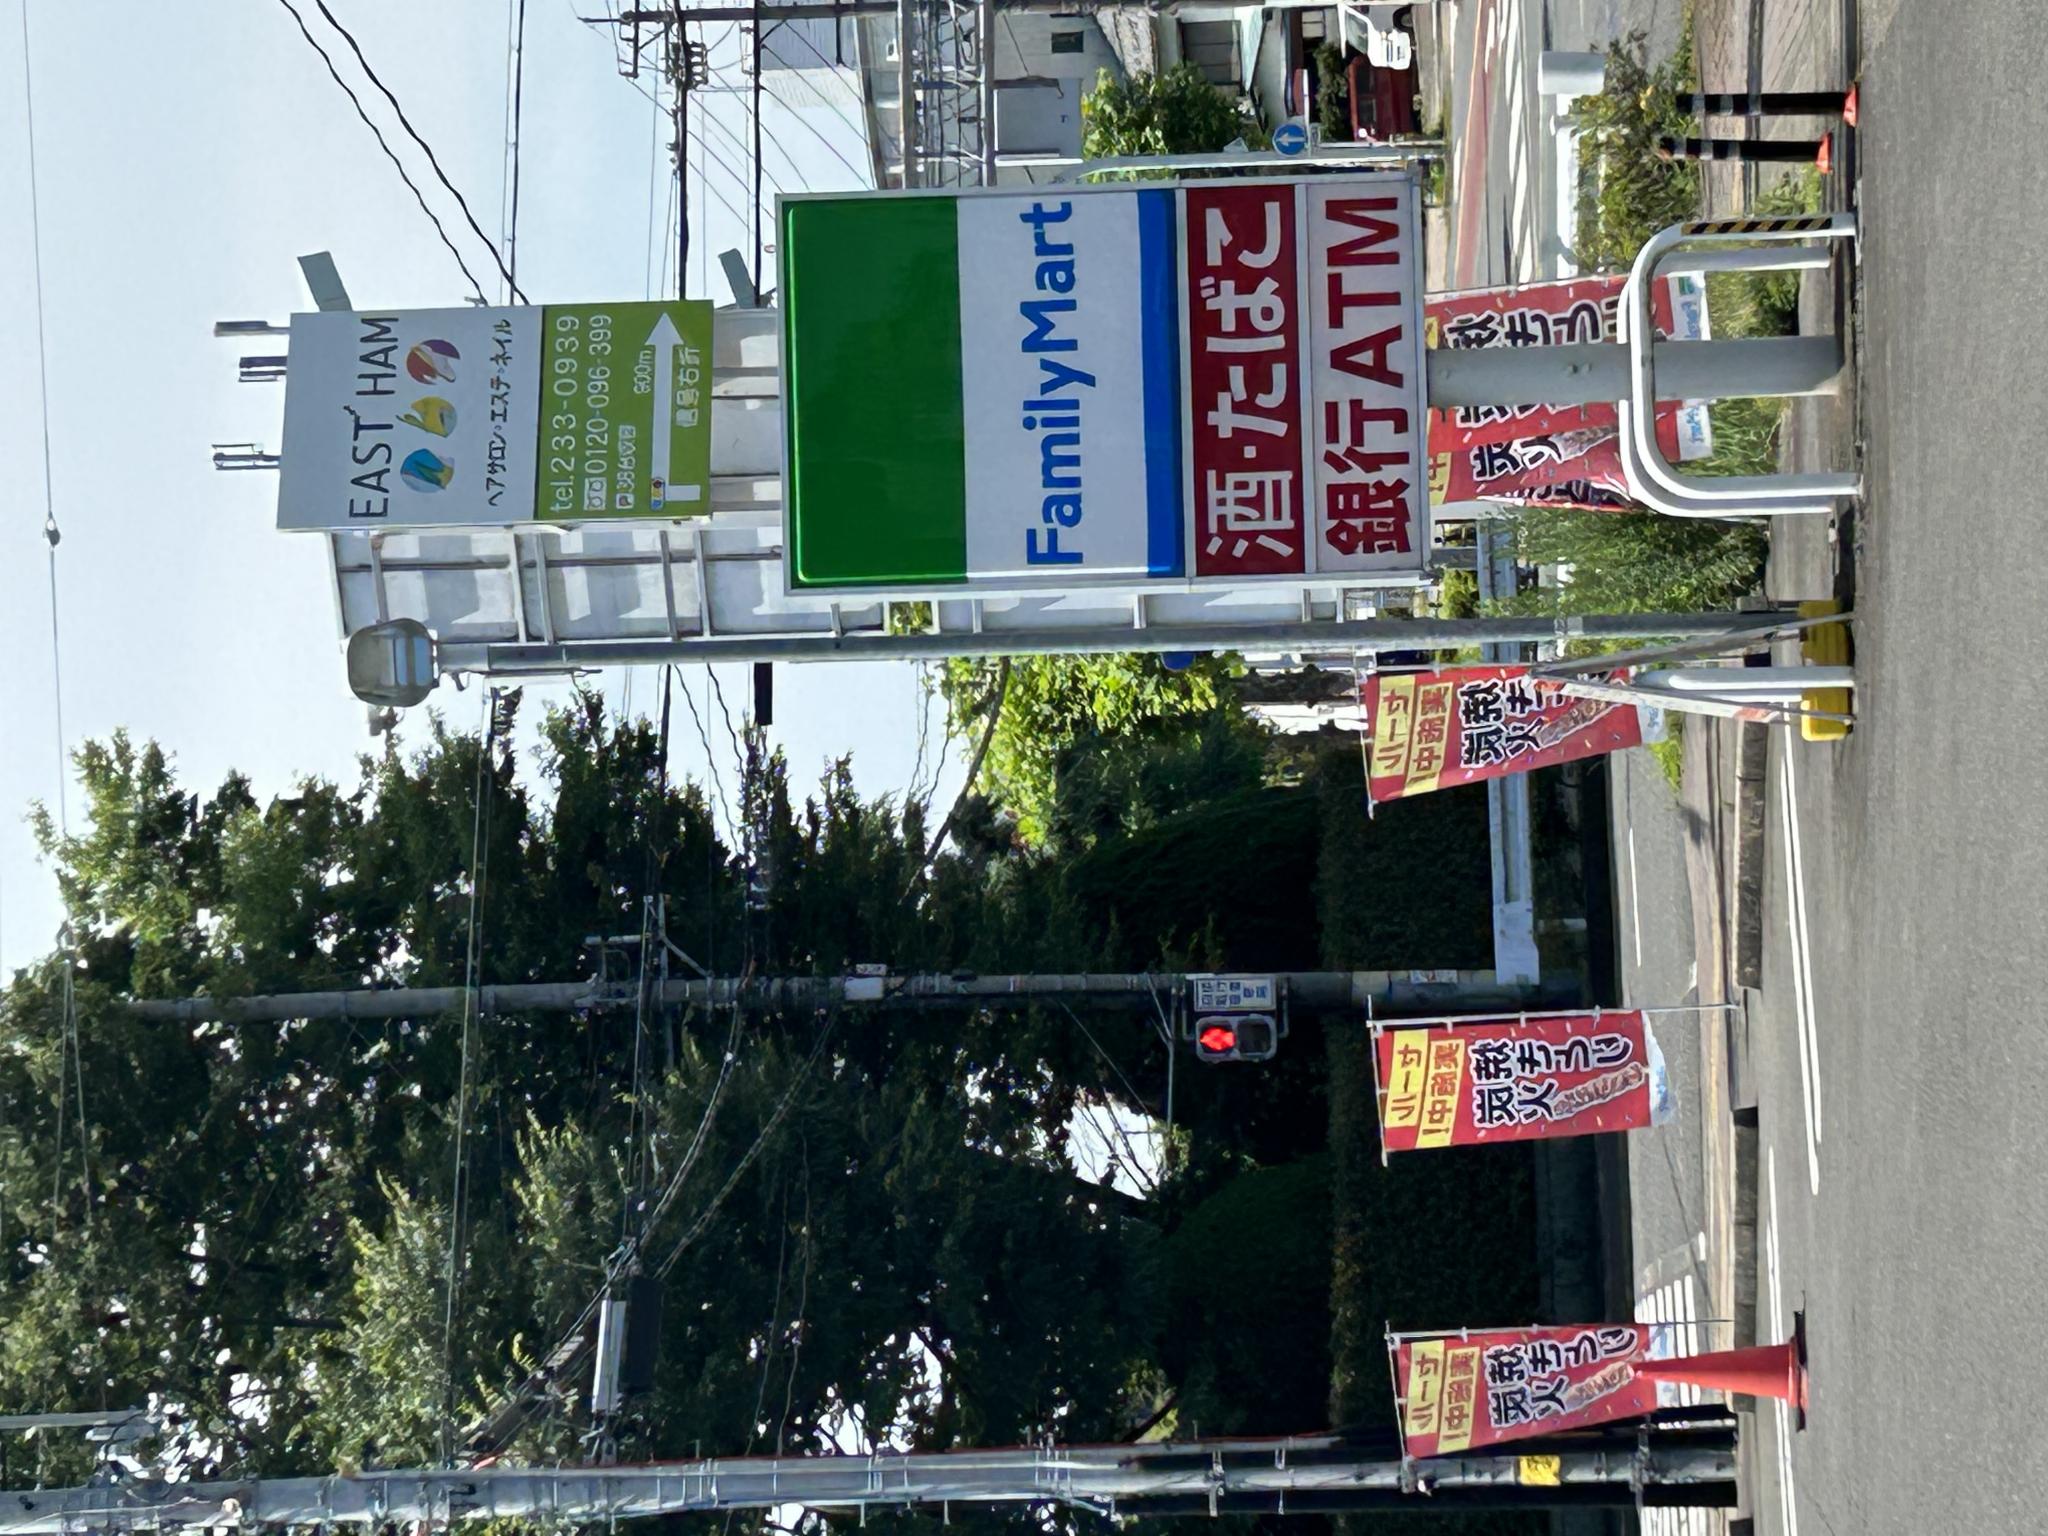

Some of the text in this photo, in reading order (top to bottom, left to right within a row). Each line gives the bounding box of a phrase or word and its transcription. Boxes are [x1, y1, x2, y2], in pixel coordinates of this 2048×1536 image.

[355, 317, 400, 396] HAM
[584, 315, 612, 474] 0120-096-399
[1019, 201, 1096, 566] FamilyMart
